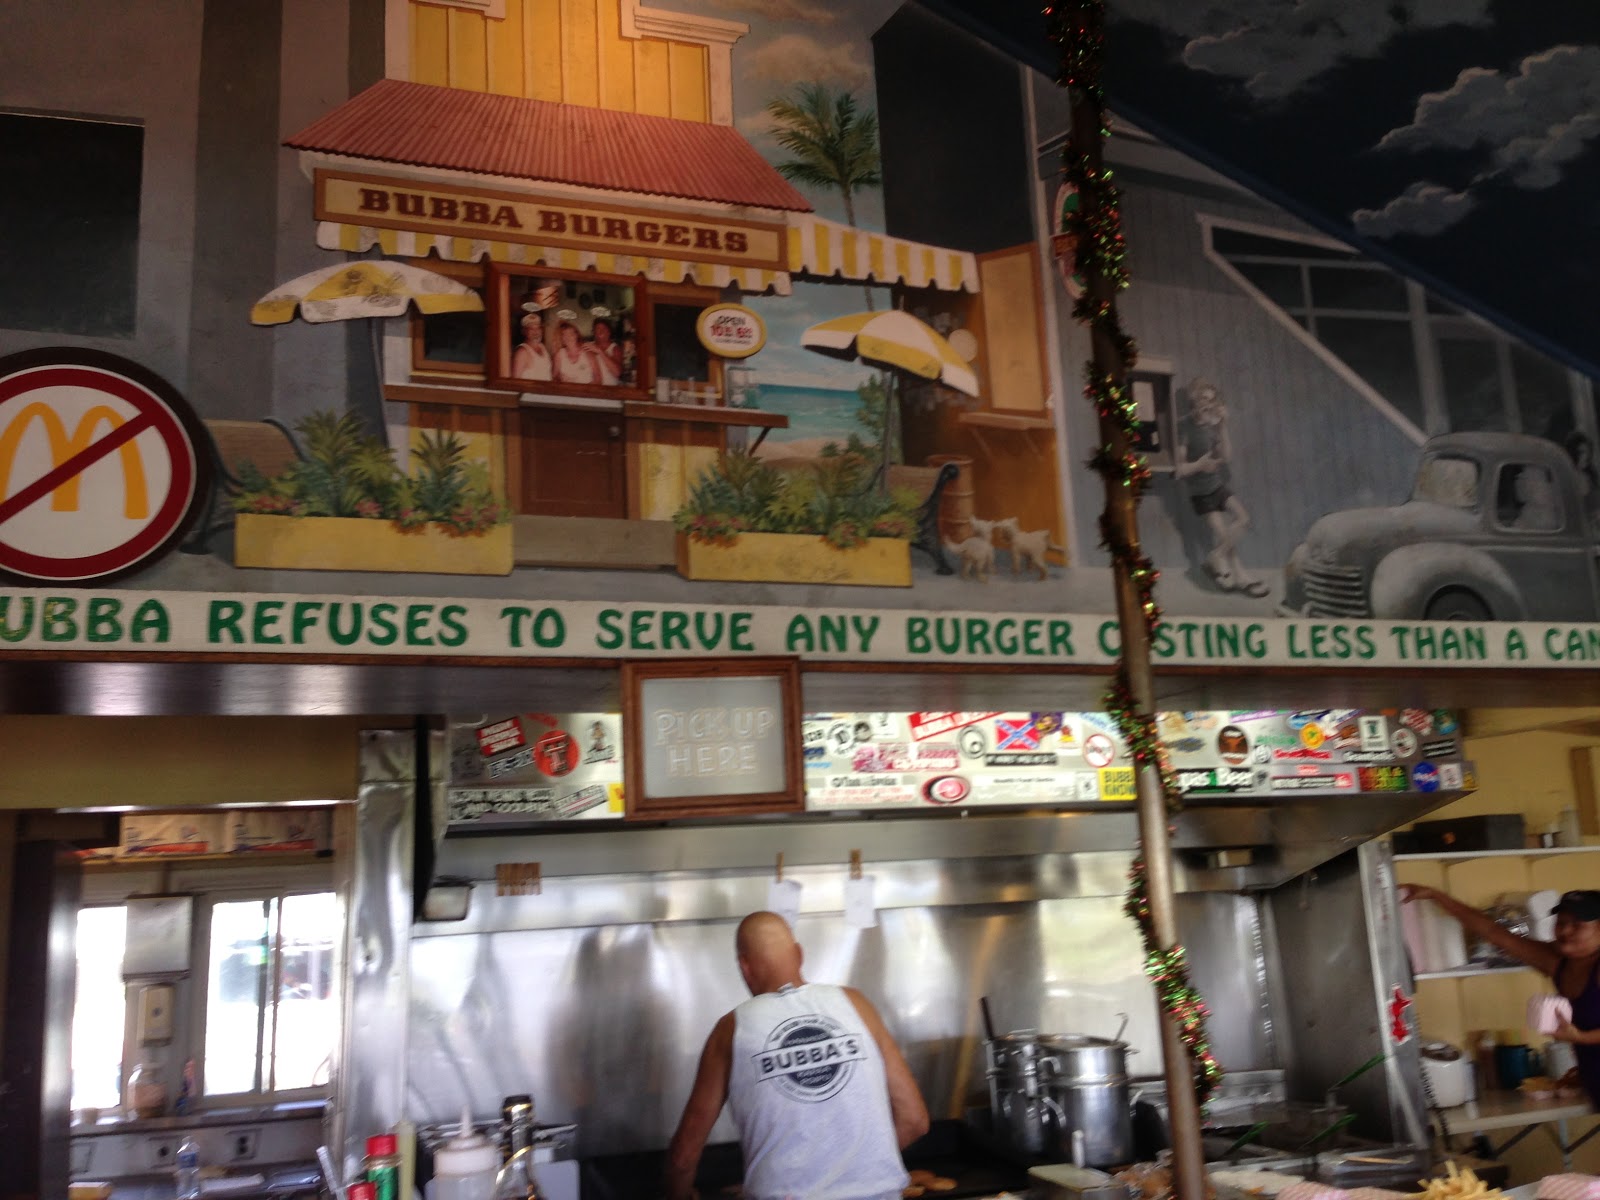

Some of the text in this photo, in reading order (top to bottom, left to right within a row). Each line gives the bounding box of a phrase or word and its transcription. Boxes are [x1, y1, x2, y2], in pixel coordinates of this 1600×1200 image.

[358, 186, 750, 254] BUBBA BURGERS
[0, 596, 172, 643] UBBA
[207, 600, 469, 646] REFUSES
[501, 606, 567, 649] TO
[596, 608, 755, 651] SERVE
[786, 613, 881, 653] ANY
[906, 617, 1075, 656] BURGER
[1099, 619, 1267, 659] CSTING
[1287, 624, 1377, 660] LESS
[1390, 626, 1489, 661] THAN
[1505, 627, 1528, 661] A
[655, 707, 774, 747] PICK UP
[667, 744, 759, 777] HERE
[761, 1038, 860, 1075] BUBBA'S
